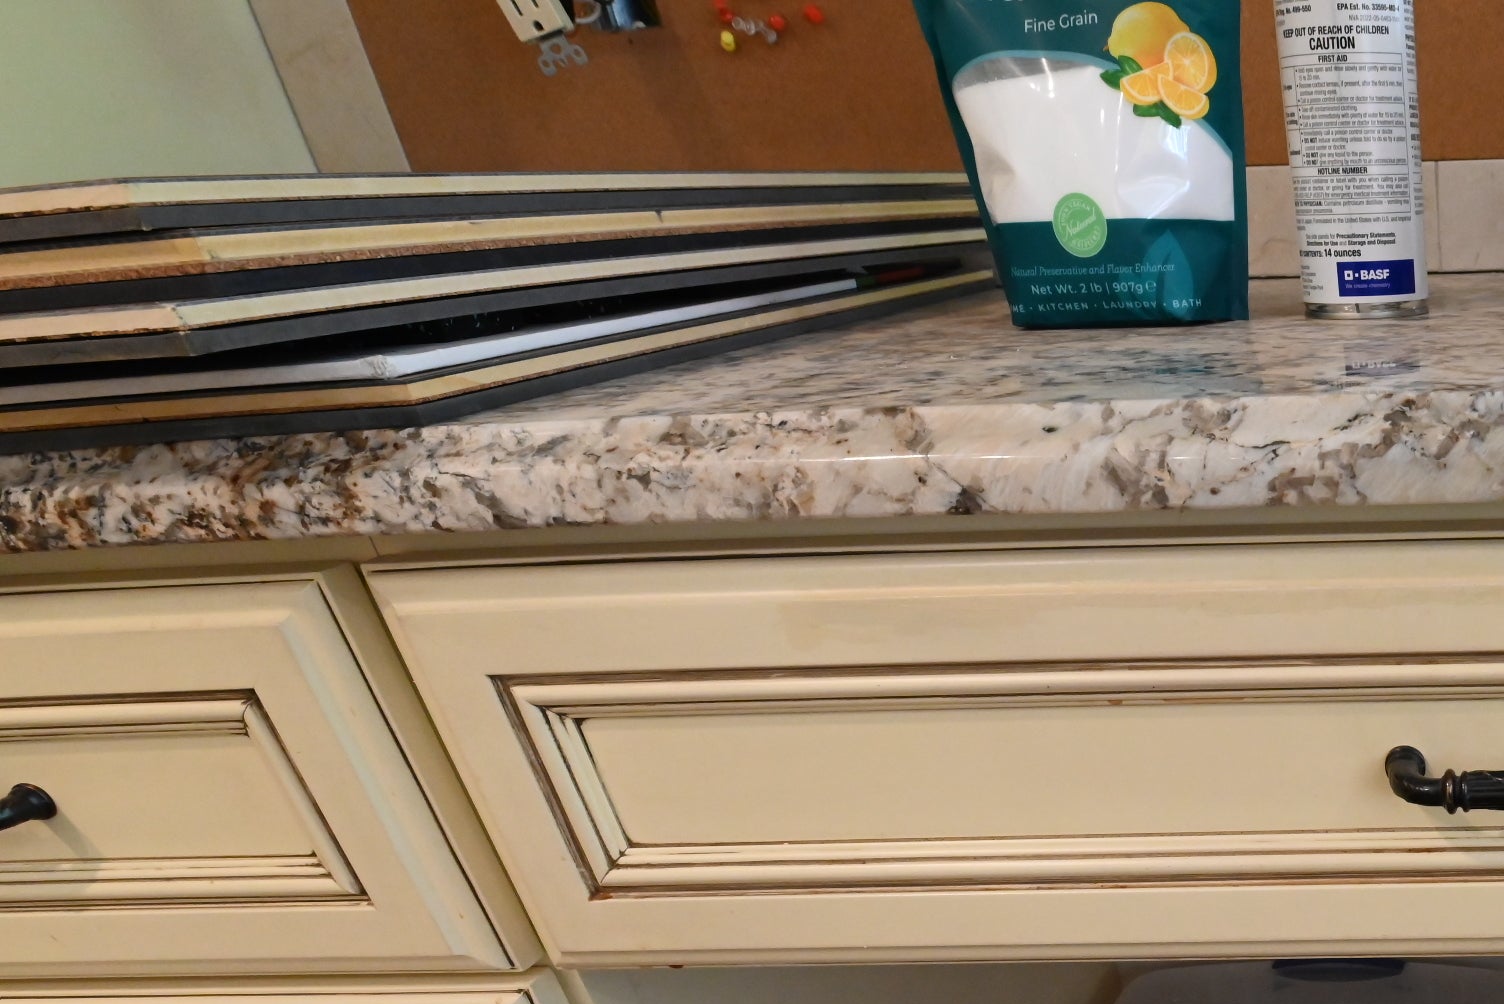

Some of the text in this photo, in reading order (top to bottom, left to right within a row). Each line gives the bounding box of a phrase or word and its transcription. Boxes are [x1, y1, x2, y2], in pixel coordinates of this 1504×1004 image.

[1024, 10, 1098, 33] Fine Grain
[1283, 25, 1389, 38] KEEP OUT OF REACH OF CHILDREN
[1310, 36, 1355, 50] CAUTION
[1318, 55, 1335, 63] FIRST
[1318, 166, 1368, 175] HOTLINE NUMBER
[1324, 249, 1332, 257] 14
[1334, 249, 1361, 257] ounces
[1011, 263, 1175, 276] Natural Preservative and Flavor Enhancer
[1361, 269, 1389, 280] BASF
[1031, 281, 1143, 295] Net Wt. 2 lb 907g
[1039, 303, 1089, 312] KITCHEN
[1103, 301, 1157, 309] LAUNDRY
[1172, 299, 1202, 308] BATH
